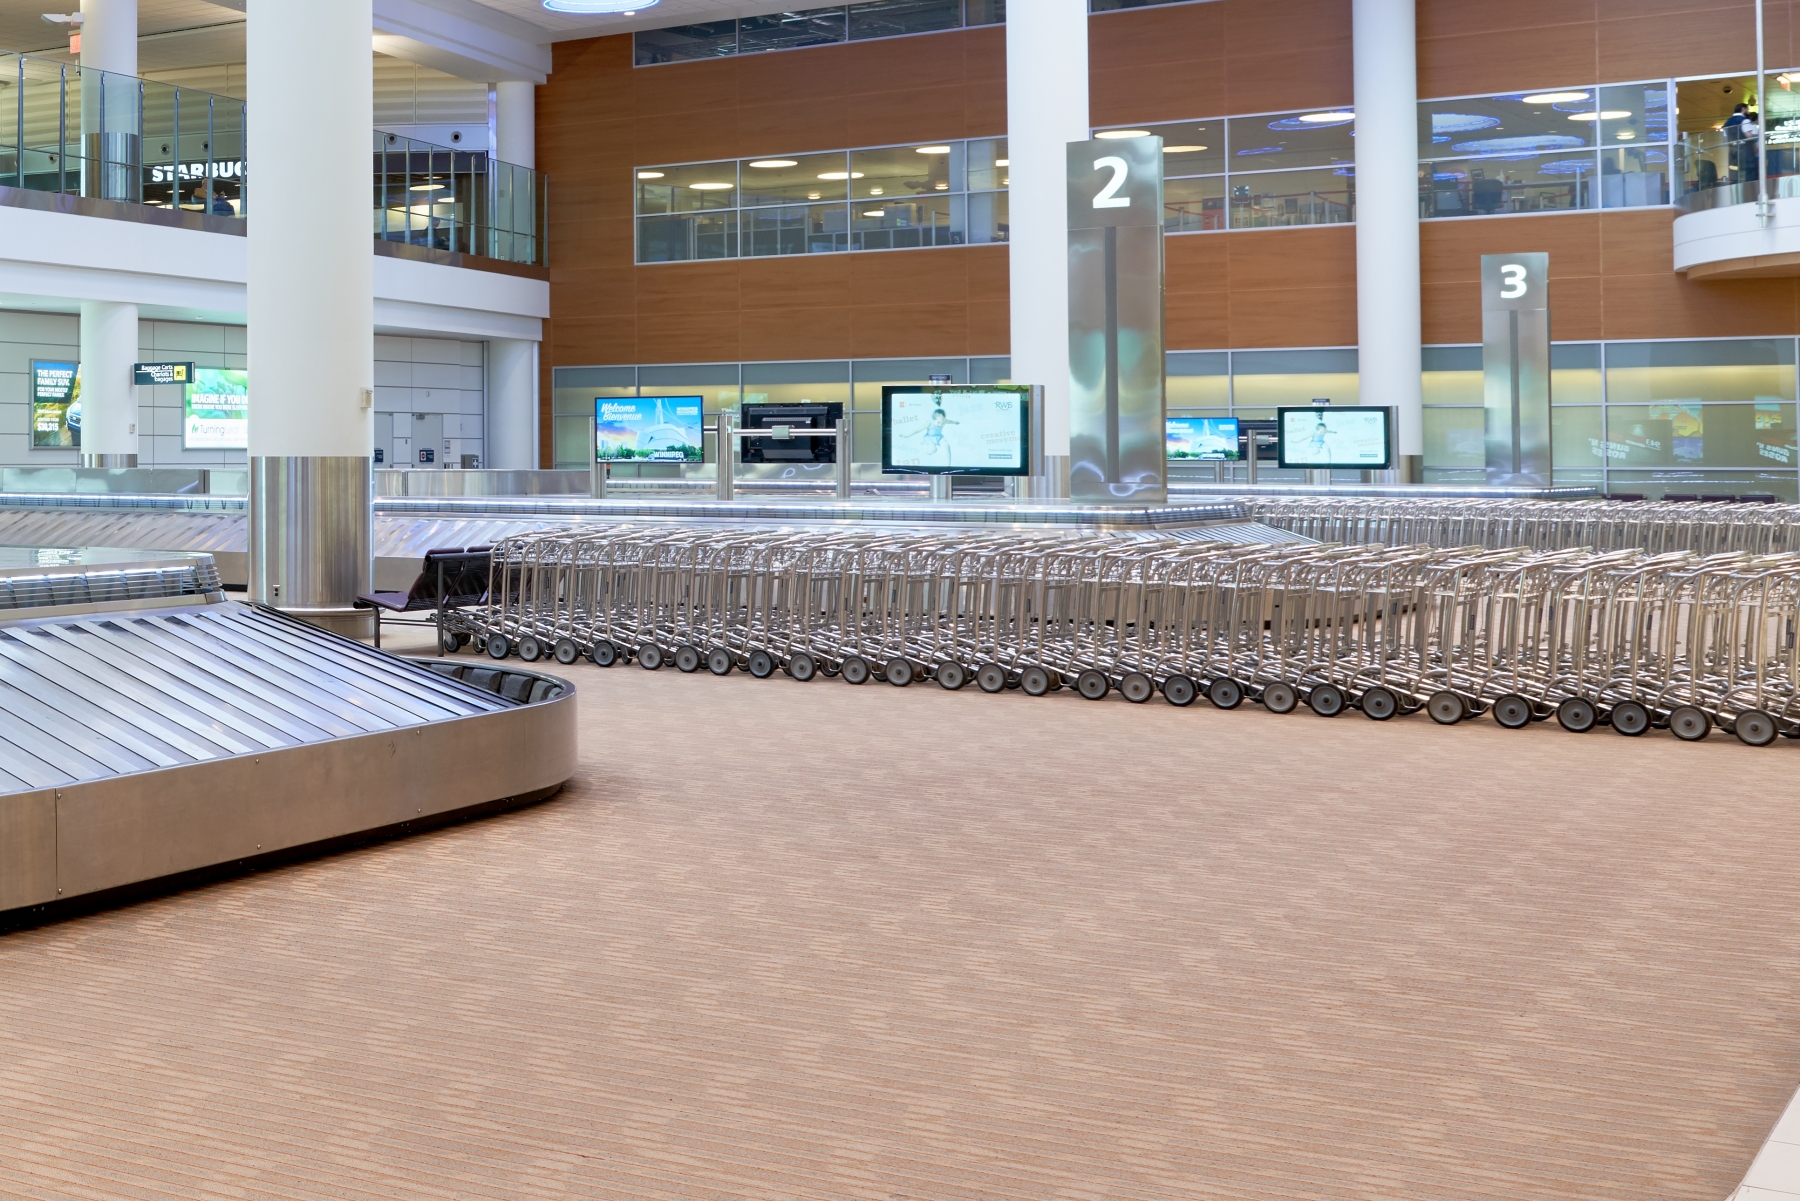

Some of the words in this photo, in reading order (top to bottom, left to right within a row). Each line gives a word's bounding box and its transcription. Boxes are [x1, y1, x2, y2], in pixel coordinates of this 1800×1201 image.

[1092, 156, 1130, 208] 2
[1500, 264, 1528, 298] 3
[49, 370, 73, 378] PERFECT
[192, 394, 219, 404] IMAGINE
[220, 394, 226, 404] IF
[227, 395, 241, 404] YOU
[601, 402, 636, 413] Welcome
[996, 401, 1012, 410] RWB
[603, 412, 642, 420] Bienvenue
[892, 414, 918, 425] ballet
[980, 430, 1016, 439] creative
